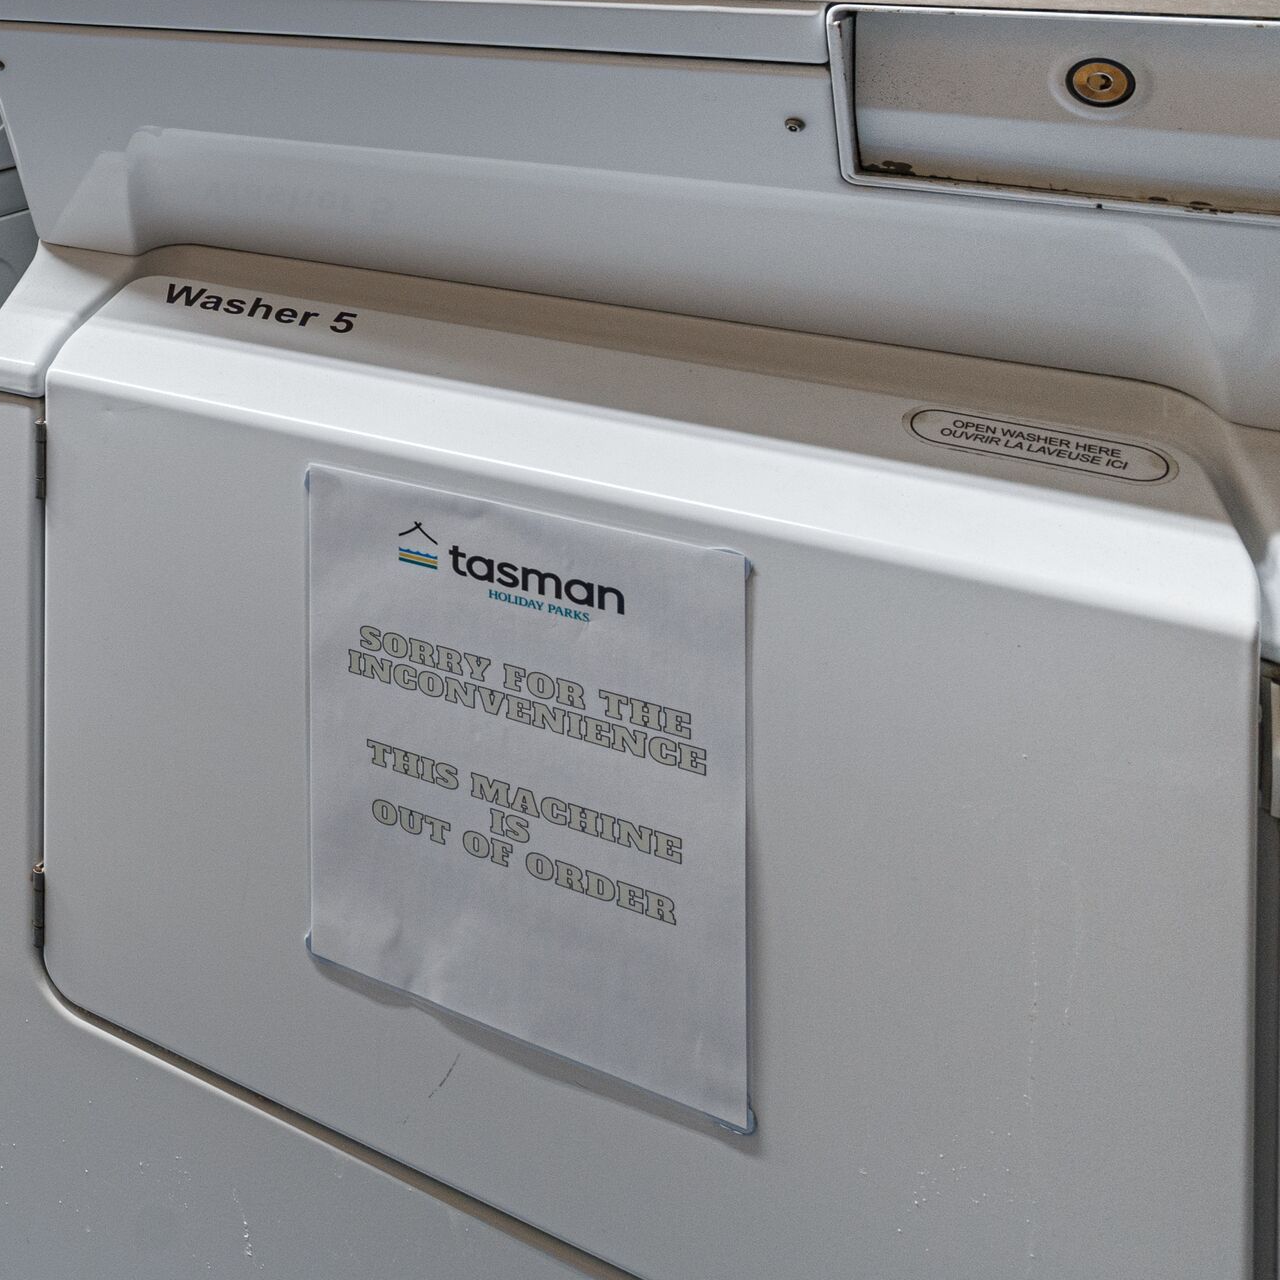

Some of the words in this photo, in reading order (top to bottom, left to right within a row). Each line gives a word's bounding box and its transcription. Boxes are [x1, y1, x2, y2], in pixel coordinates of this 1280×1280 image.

[166, 283, 320, 327] Washer
[329, 311, 357, 334] 5
[940, 427, 1001, 446] OUVRIR
[1004, 439, 1025, 451] LA
[1026, 442, 1101, 466] LAVEUSE
[1105, 457, 1129, 470] ICI
[952, 419, 997, 435] OPEN
[1000, 427, 1071, 449] WASHER
[1075, 441, 1122, 458] HERE
[448, 544, 626, 615] tasman
[488, 588, 544, 611] HOLIDAY
[548, 603, 591, 623] PARKS
[348, 648, 708, 776] INCONVENIENCE
[359, 625, 492, 683] SORRY
[503, 662, 586, 710] FOR
[598, 689, 692, 740] THE
[366, 738, 460, 791] THIS
[470, 772, 684, 865] MACHINE
[489, 807, 530, 845] IS
[371, 798, 452, 846] OUT
[462, 829, 514, 868] OF
[525, 851, 677, 926] ORDER
